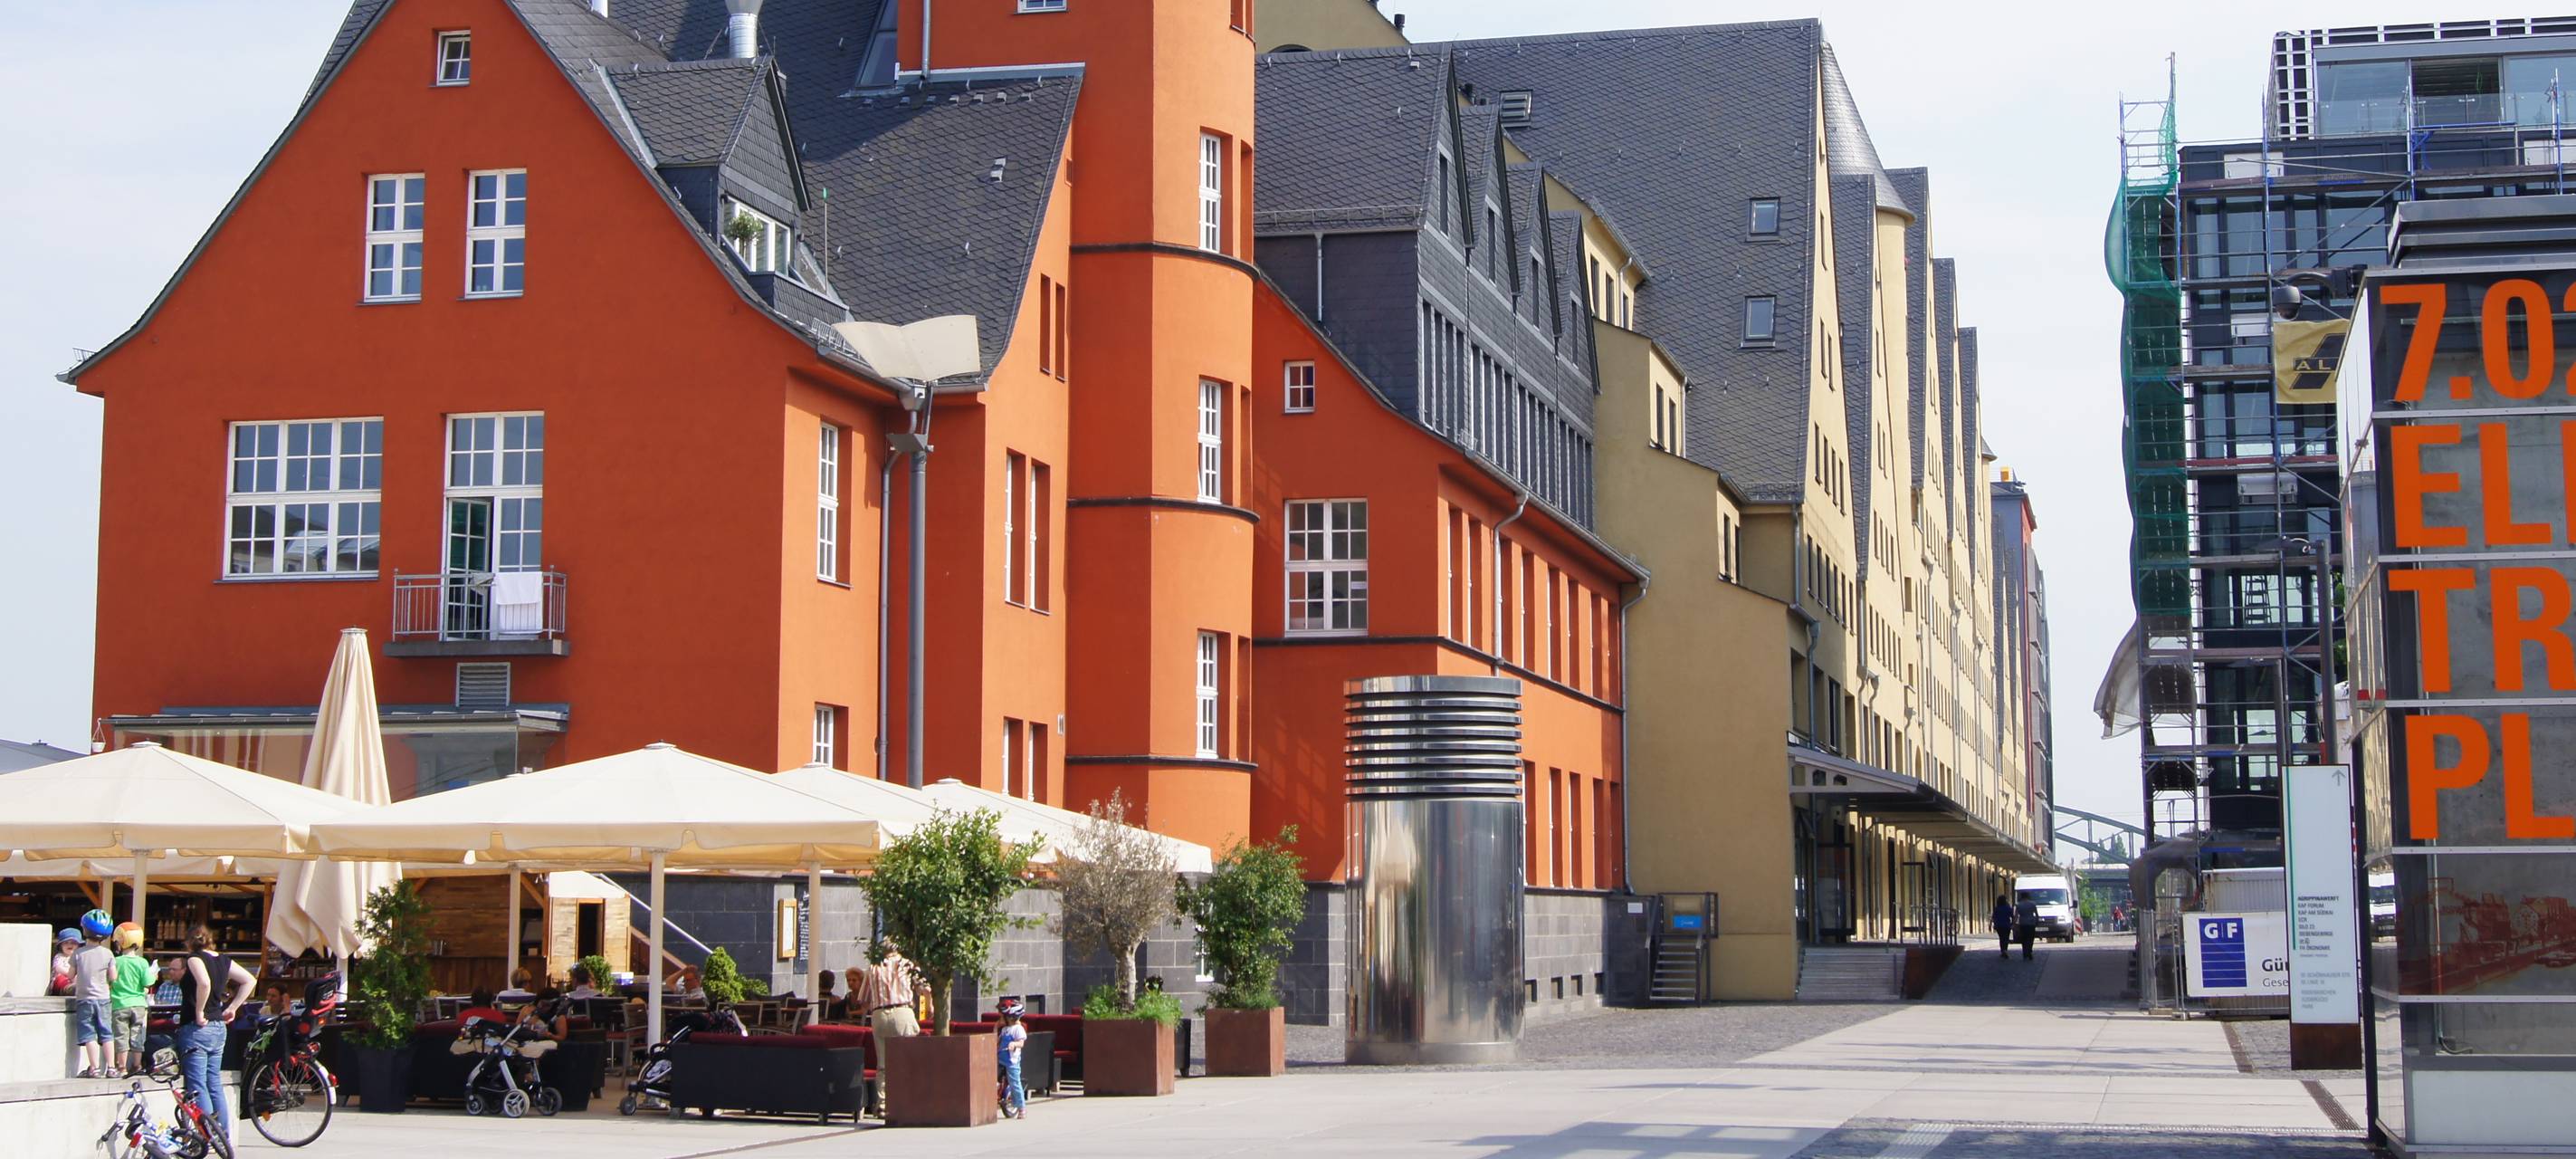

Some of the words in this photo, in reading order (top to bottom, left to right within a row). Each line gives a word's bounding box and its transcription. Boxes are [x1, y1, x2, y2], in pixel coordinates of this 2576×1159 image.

[2380, 279, 2576, 401] 7.0
[2390, 420, 2576, 548] EL
[2388, 566, 2576, 693] TR
[2405, 713, 2575, 839] PL
